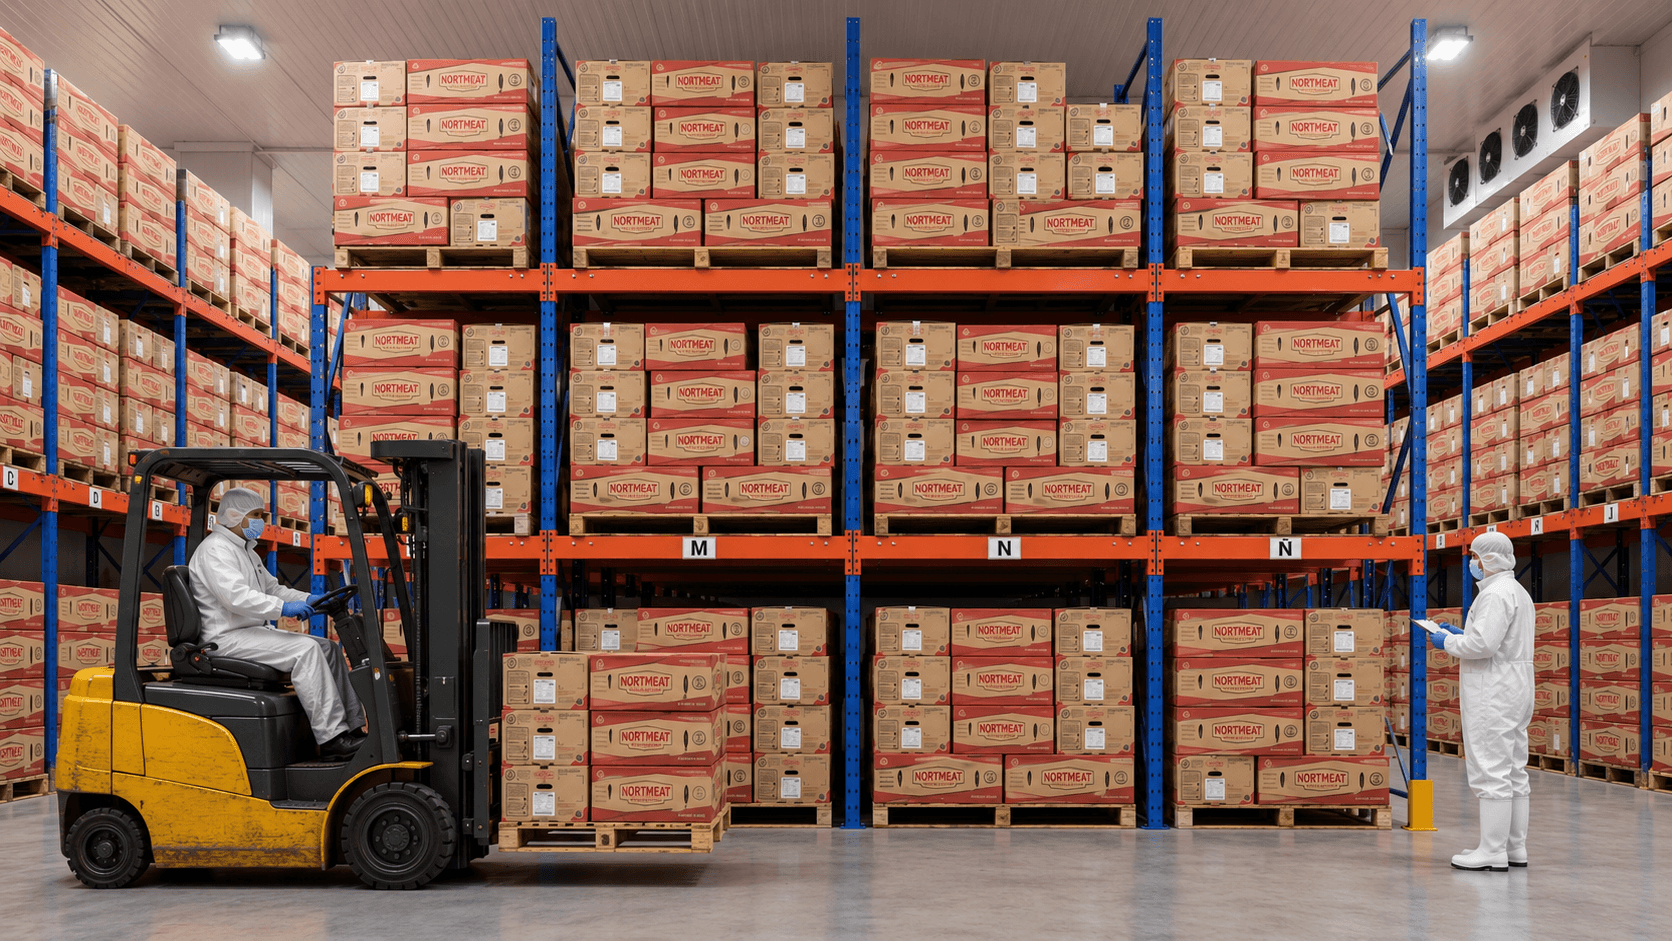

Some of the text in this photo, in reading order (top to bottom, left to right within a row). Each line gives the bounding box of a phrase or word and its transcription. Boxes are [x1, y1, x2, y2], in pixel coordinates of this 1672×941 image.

[1292, 78, 1337, 88] NORTMEAT
[442, 120, 485, 129] NORTMEAT
[681, 123, 724, 132] NORTMEAT
[1292, 122, 1337, 132] NORTMEAT
[681, 169, 723, 179] NORTMEAT
[1293, 168, 1338, 178] NORTMEAT
[370, 212, 412, 222] NORTMEAT
[614, 216, 660, 226] NORTMEAT
[743, 216, 788, 225] NORTMEAT
[907, 215, 951, 225] NORTMEAT
[1215, 216, 1260, 226] NORTMEAT
[1047, 218, 1093, 228] NORTMEAT
[376, 335, 417, 345] NORTMEAT
[671, 339, 713, 349] NORTMEAT
[1294, 339, 1340, 348] NORTMEAT
[984, 341, 1026, 352] NORTMEAT
[375, 383, 417, 393] NORTMEAT
[679, 387, 723, 397] NORTMEAT
[984, 388, 1027, 398] NORTMEAT
[1293, 385, 1339, 395] NORTMEAT
[678, 435, 723, 445] NORTMEAT
[983, 437, 1027, 446] NORTMEAT
[1294, 434, 1340, 444] NORTMEAT
[7, 471, 14, 485] C
[610, 483, 656, 493] NORTMEAT
[742, 483, 787, 493] NORTMEAT
[915, 483, 962, 493] NORTMEAT
[1045, 484, 1091, 494] NORTMEAT
[1215, 483, 1260, 493] NORTMEAT
[93, 491, 99, 504] D
[1608, 507, 1614, 519] J
[691, 540, 707, 556] M
[998, 540, 1011, 556] N
[1279, 538, 1292, 556] Ñ
[667, 623, 711, 633] NORTMEAT
[978, 625, 1021, 636] NORTMEAT
[1215, 626, 1261, 637] NORTMEAT
[621, 675, 670, 687] NORTMEAT
[979, 674, 1022, 684] NORTMEAT
[1215, 676, 1261, 686] NORTMEAT
[622, 731, 670, 742] NORTMEAT
[915, 771, 962, 781] NORTMEAT
[1044, 773, 1091, 782] NORTMEAT
[1298, 773, 1344, 783] NORTMEAT
[622, 786, 671, 798] NORTMEAT
